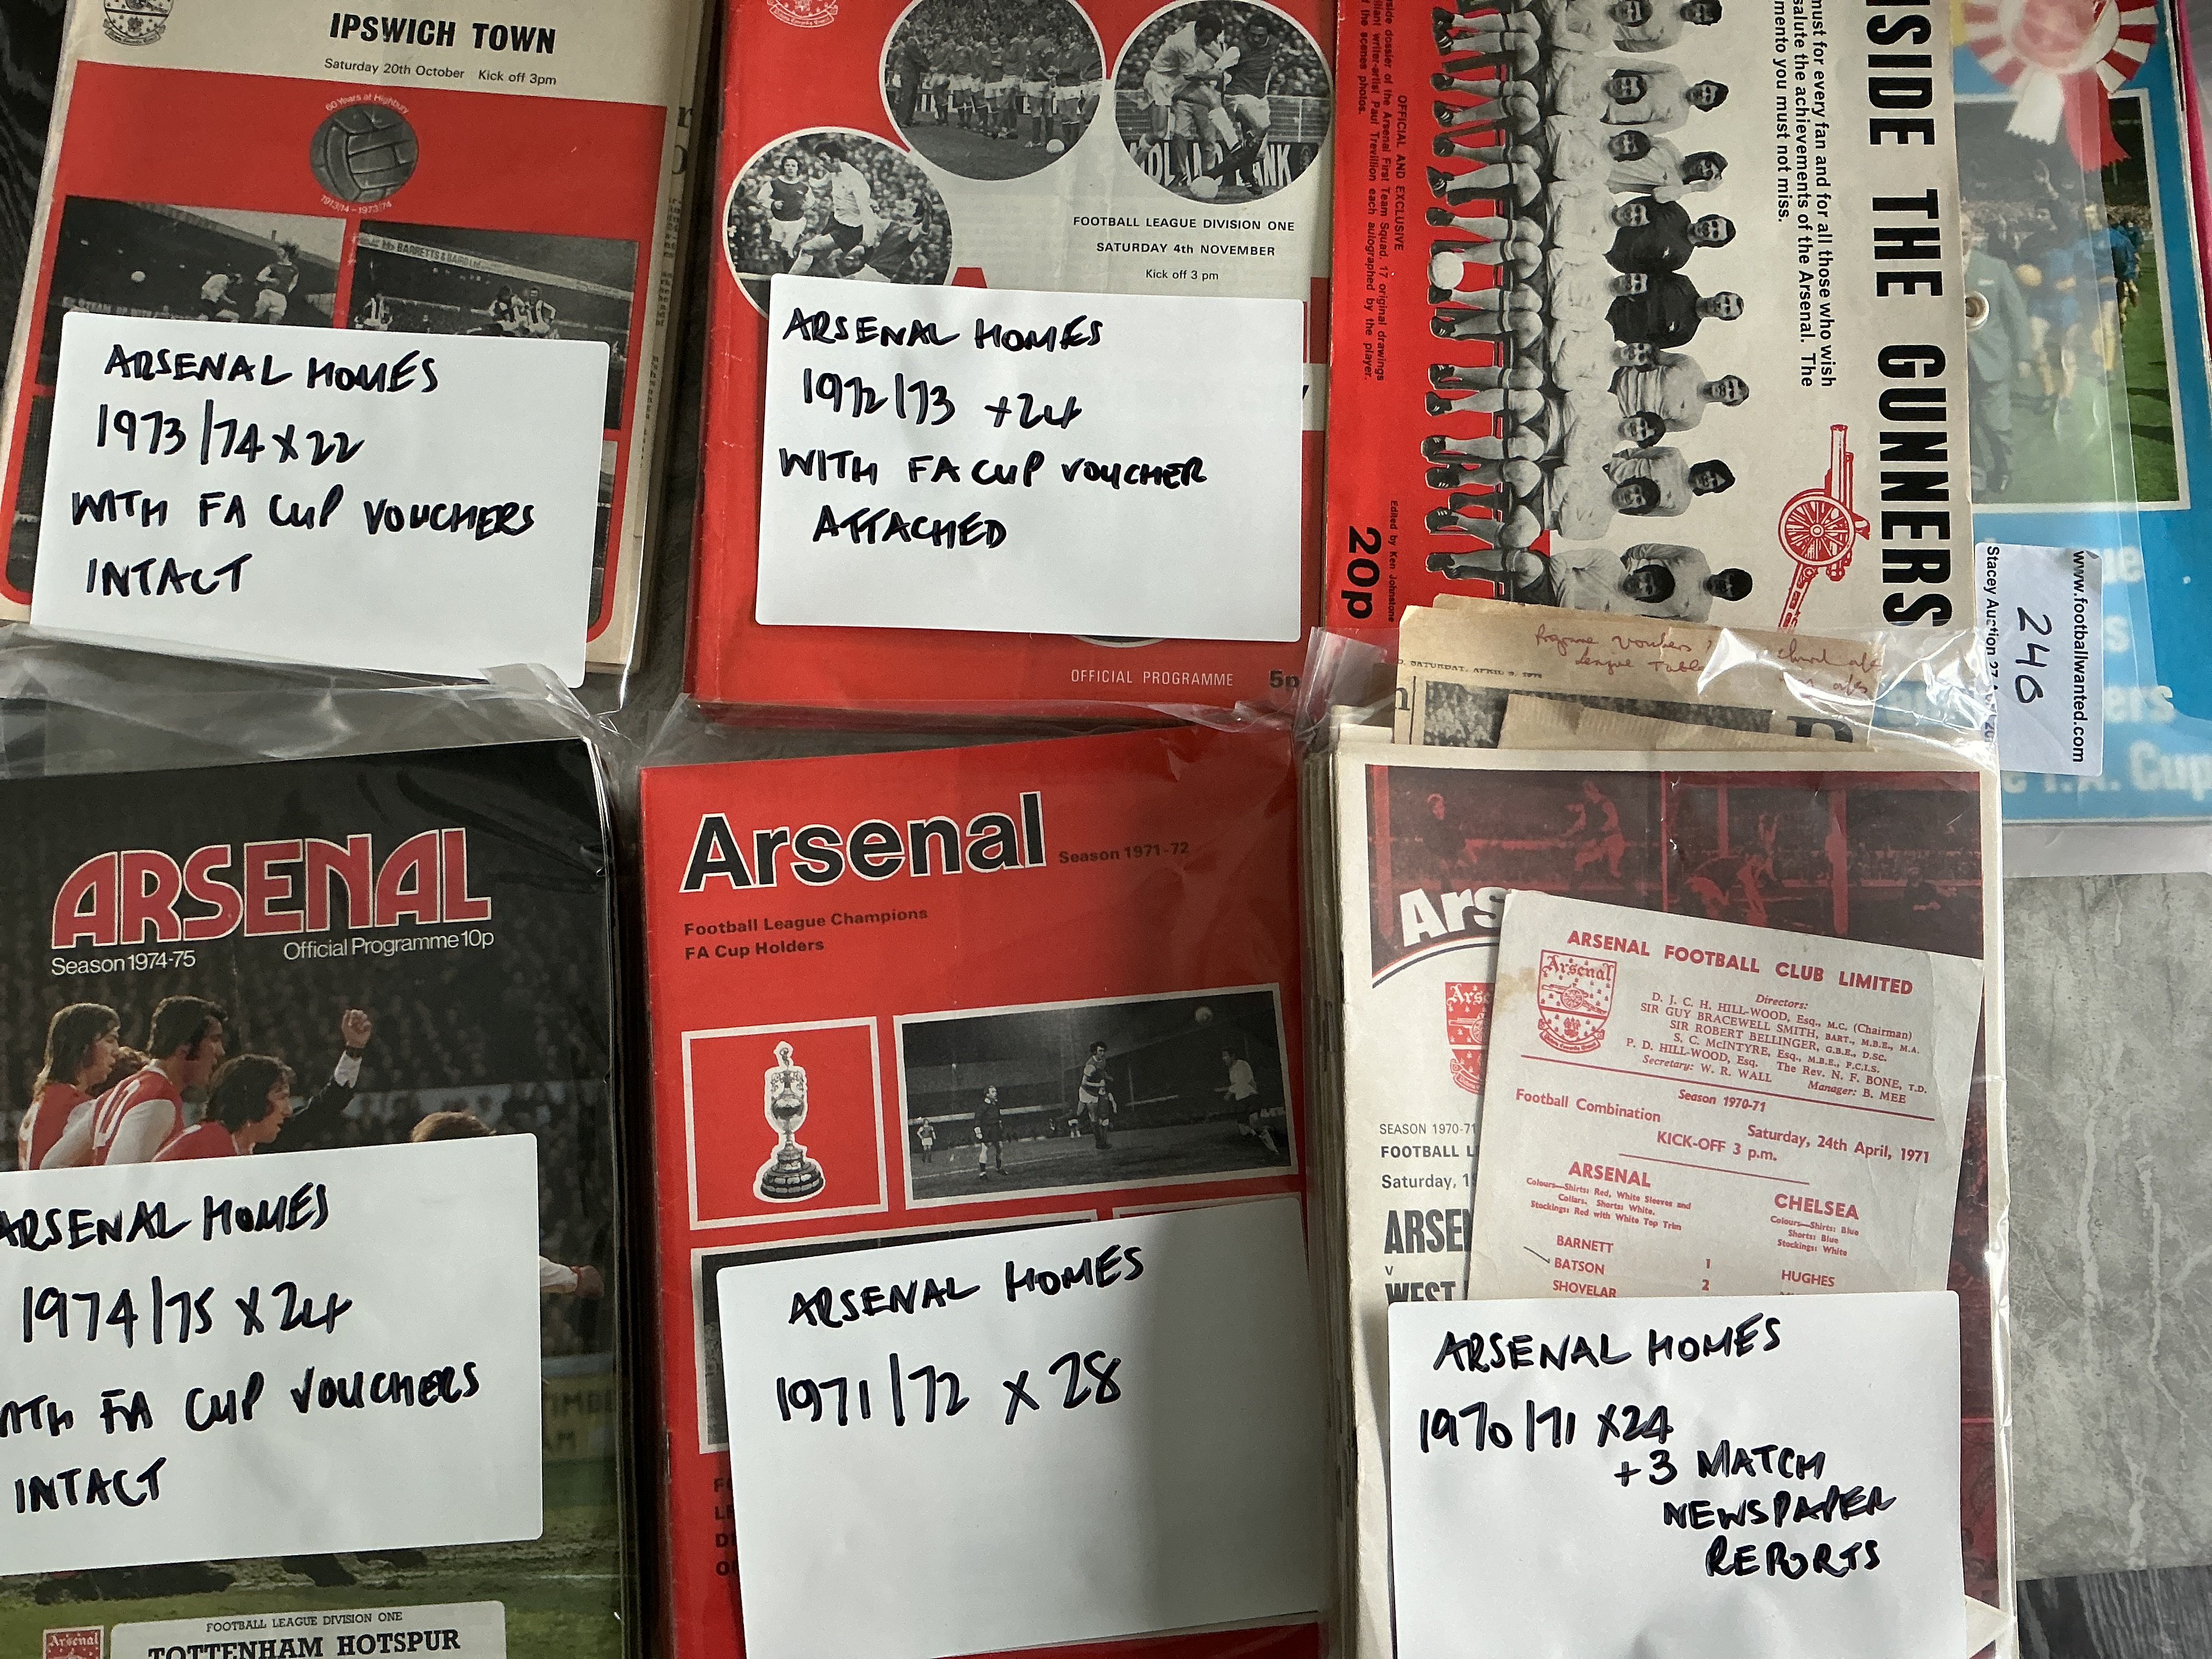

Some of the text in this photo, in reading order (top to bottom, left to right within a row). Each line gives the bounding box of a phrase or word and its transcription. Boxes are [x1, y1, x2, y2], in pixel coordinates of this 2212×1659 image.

[329, 12, 556, 54] IPSWICH TOWN
[324, 58, 557, 86] Saturday 20th October Kick off 3pm
[1794, 54, 1809, 81] the
[336, 94, 362, 105] Years
[374, 94, 410, 115] Highbury
[1795, 87, 1812, 208] achievements
[1394, 94, 1408, 251] OFFICIAL AND EXCLUSIVE
[1811, 0, 1837, 387] must for every fan and for all those who wish
[1073, 216, 1295, 231] FOOTBALL LEAGUE DIVISION ONE
[1797, 213, 1813, 231] of
[1097, 242, 1275, 256] SATURDAY 4th NOVEMBER
[1375, 157, 1391, 382] First Team Squad. 17 original drawings
[1798, 236, 1814, 264] the
[1146, 269, 1219, 282] Kick off 3 pm
[1798, 270, 1816, 343] Arsenal.
[782, 307, 1104, 353] ARSENAL HOMES
[104, 343, 439, 393] ARSENAL HOMES
[1801, 353, 1816, 387] The
[802, 368, 956, 426] 1972/73
[1872, 189, 1953, 627] THE GUNNERS
[778, 447, 1208, 490] WITH FA CUP VOUCHER
[71, 484, 534, 540] WITH FA CUP VOUCHERS
[812, 505, 1008, 550] ATTACHED
[86, 552, 253, 598] INTACT
[1341, 526, 1382, 619] 20p
[1388, 500, 1398, 623] Edited by Ken Johnstone
[1983, 546, 2000, 595] Stacey
[2072, 550, 2089, 763] www.footballwanted.com
[1071, 669, 1300, 691] OFFICIAL PROGRAMME 5p
[679, 790, 1189, 894] Arsenal Season 1971-72
[52, 827, 492, 949] ARSENAL
[684, 906, 928, 936] Football League Champions
[51, 929, 495, 976] Season 1974-75 Official Programme 10p
[685, 938, 825, 961] FA Cup Holders
[1542, 955, 1614, 981] Arsenal
[1567, 930, 1914, 995] ARSENAL FOOTBALL CLUB LIMITED
[1755, 994, 1809, 1010] Directors:
[1640, 1002, 1659, 1014] SIR
[1665, 1006, 1690, 1019] GUY
[1697, 1012, 1770, 1030] BRACEWELL
[1776, 1024, 1819, 1040] SMITH,
[1900, 1044, 1920, 1054] M.A.
[1515, 1088, 1661, 1122] Football Combination
[1678, 1089, 1766, 1113] Season 1970-71
[1379, 1124, 1476, 1135] SEASON 1970-71
[1747, 1125, 1929, 1164] Saturday, 24th April, 1971
[1381, 1145, 1459, 1158] FOOTBALL
[1381, 1173, 1457, 1190] Saturday,
[1568, 1161, 1651, 1188] ARSENAL
[0, 1181, 327, 1250] ARSENAL HOMES
[1774, 1193, 1859, 1220] CHELSEA
[1556, 1235, 1614, 1253] BARNETT
[787, 1243, 1146, 1328] ARSENAL HOMES
[1554, 1257, 1605, 1275] BATSON
[1781, 1269, 1836, 1287] HUGHES
[1553, 1280, 1617, 1298] SHOVELAR
[22, 1275, 214, 1348] 1974/75
[1433, 1312, 1782, 1373] ARSENAL HOMES
[100, 1360, 481, 1434] FA CUP VOUCHERS
[776, 1351, 970, 1427] 1971/72
[1419, 1399, 1575, 1453] 1970/71
[1697, 1439, 1826, 1480] MATCH
[14, 1456, 168, 1514] INTACT
[1663, 1485, 1897, 1530] NEWSPAPER
[1706, 1534, 1880, 1579] REPORTS
[49, 1632, 99, 1647] Arsenal
[206, 1611, 403, 1633] FOOTBALL LEAGUE DIVISION ONE
[148, 1629, 461, 1659] TOTTENHAM HOTSPUR
